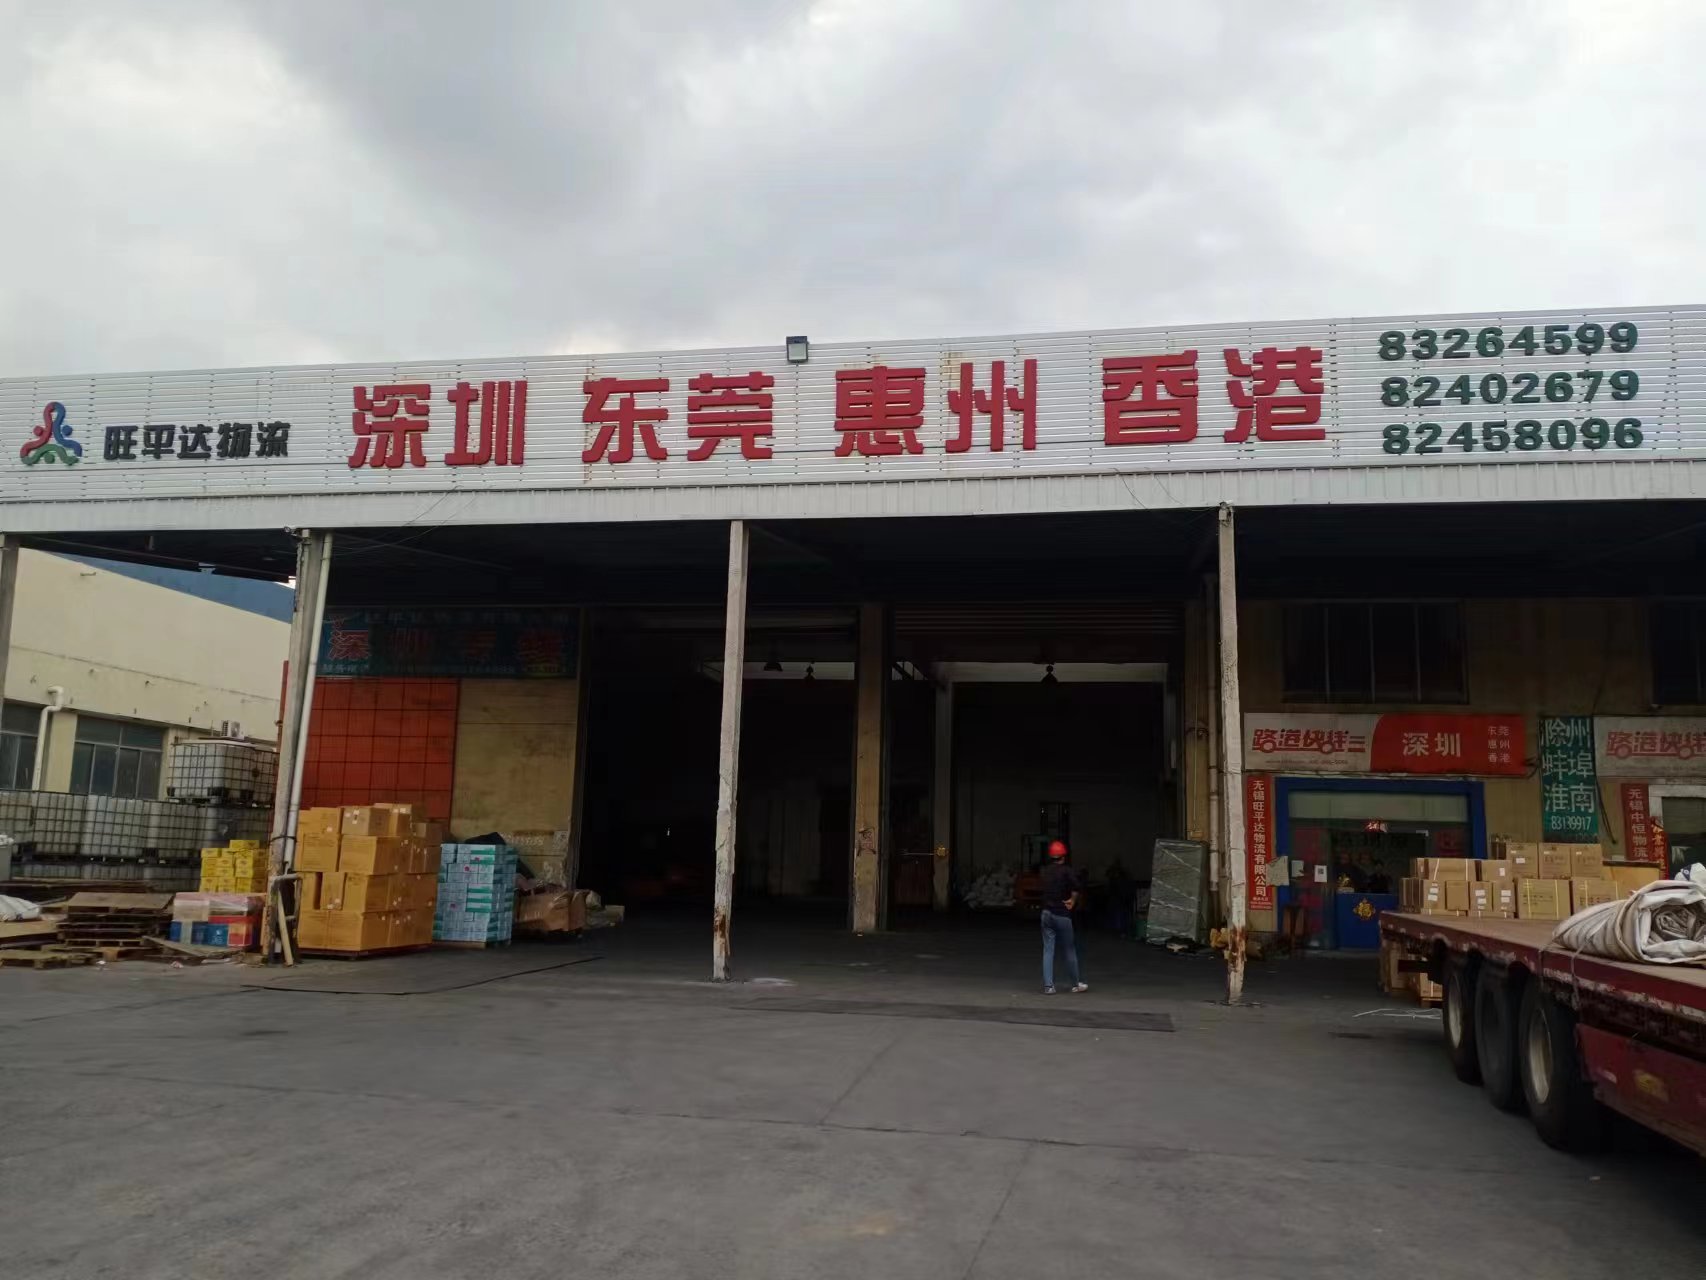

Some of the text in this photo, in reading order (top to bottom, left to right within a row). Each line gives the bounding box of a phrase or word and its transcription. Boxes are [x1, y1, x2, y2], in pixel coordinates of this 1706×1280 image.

[1378, 322, 1638, 360] 83264599
[1381, 368, 1638, 406] 82402679
[350, 347, 1325, 467] 深圳 东莞 惠州 香港
[104, 421, 291, 460] 旺平达物流
[1383, 413, 1642, 454] 82458096
[1402, 731, 1460, 758] 深圳
[1541, 718, 1591, 747] 滁州
[1542, 750, 1594, 780] 蚌埠
[1544, 784, 1594, 813] 淮南
[1252, 780, 1267, 896] 无锡旺平达物流有限公司
[1628, 788, 1649, 861] 无锡中恒物流
